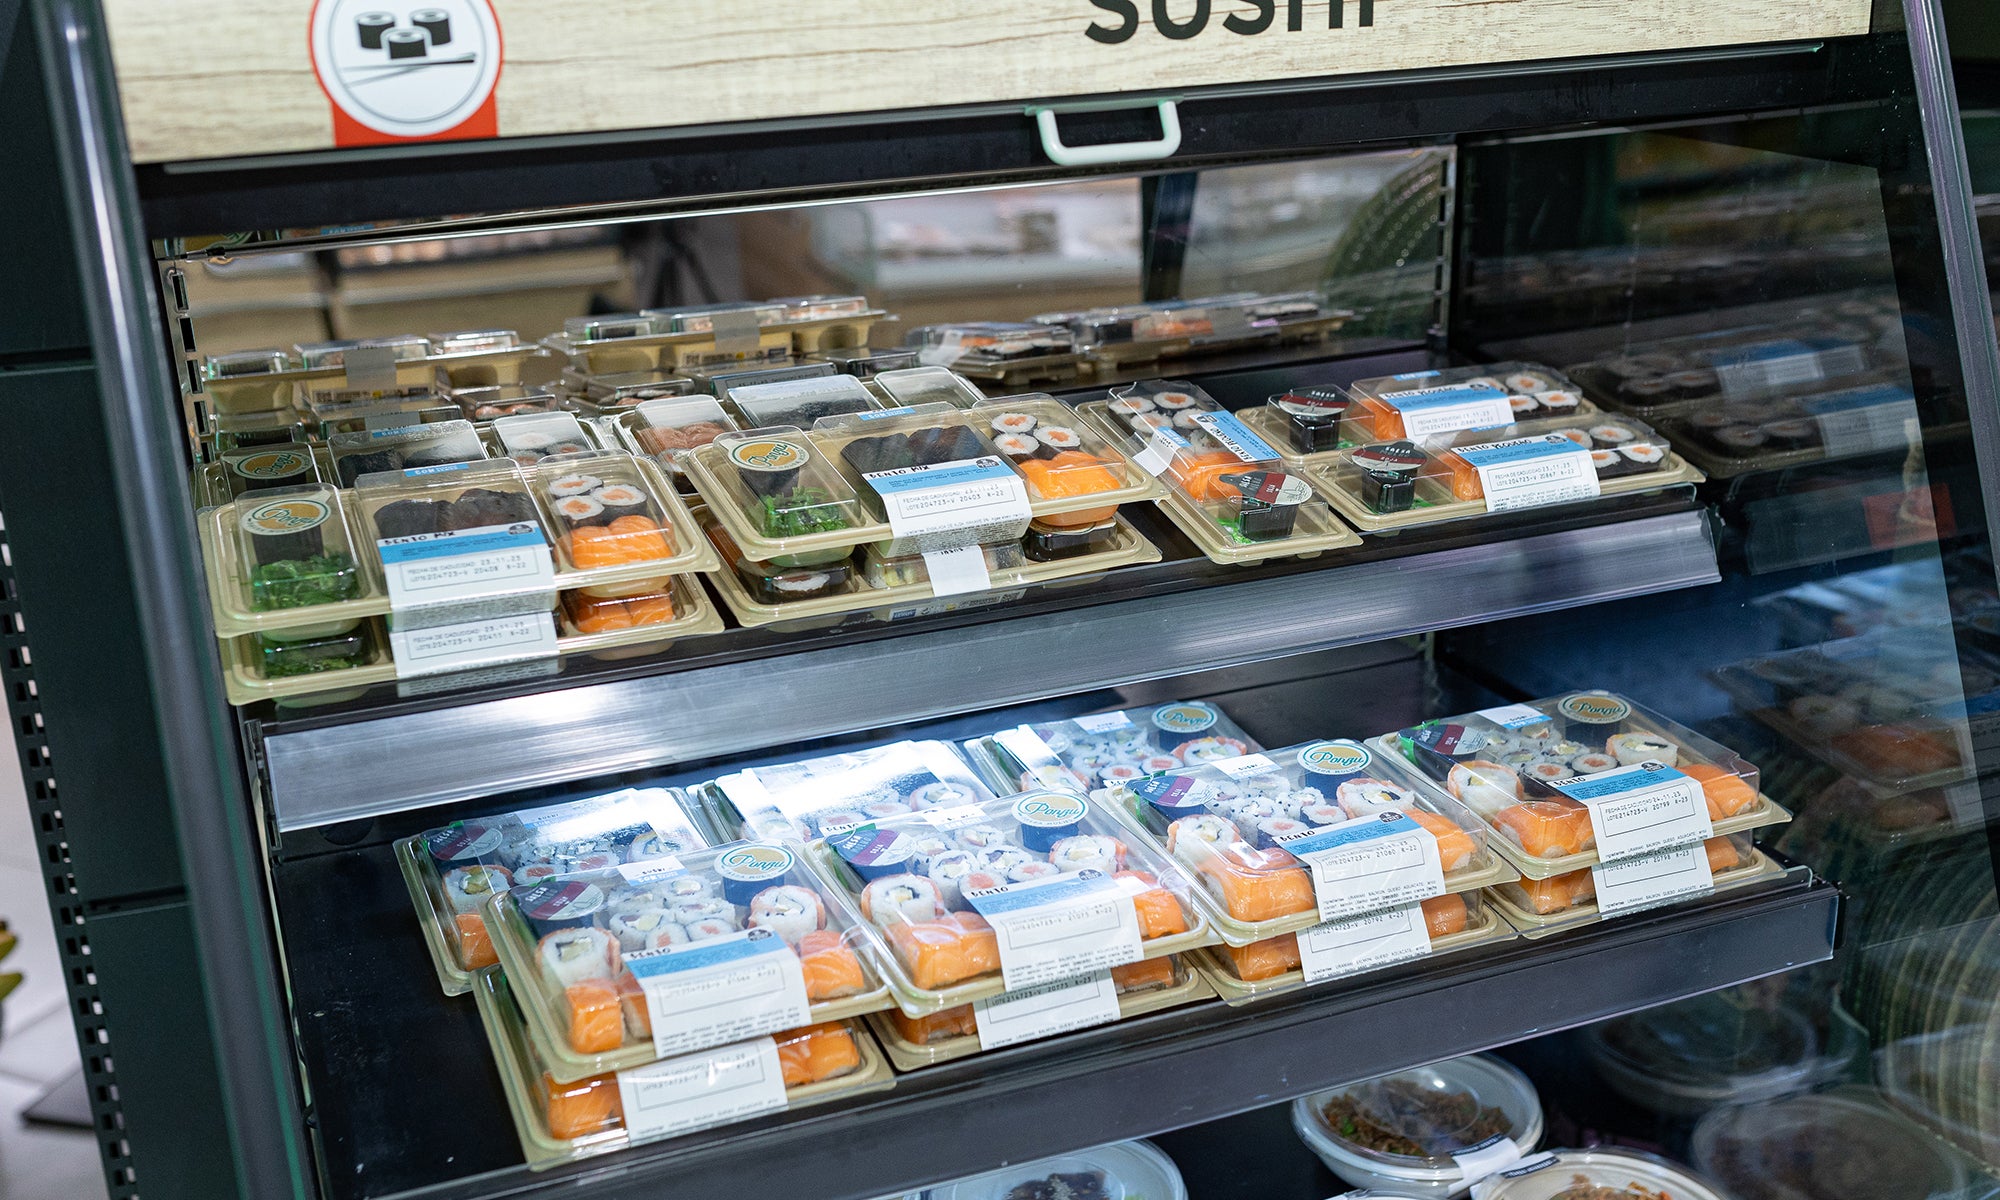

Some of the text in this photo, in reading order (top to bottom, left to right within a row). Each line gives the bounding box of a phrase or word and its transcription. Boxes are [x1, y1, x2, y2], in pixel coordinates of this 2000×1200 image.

[1385, 446, 1411, 455] SALSA
[1458, 443, 1489, 453] BENTO
[869, 468, 907, 480] BENTO
[911, 465, 931, 474] MIX
[384, 535, 427, 546] BENTO
[1310, 751, 1364, 766] Ponzu
[1144, 780, 1160, 794] SALSA
[1553, 776, 1587, 787] BENTO
[1024, 801, 1080, 818] Ponzu
[1279, 830, 1315, 842] BENTO
[842, 835, 863, 851] SALSA
[524, 886, 549, 903] SALSA
[971, 886, 1009, 898] BENTO
